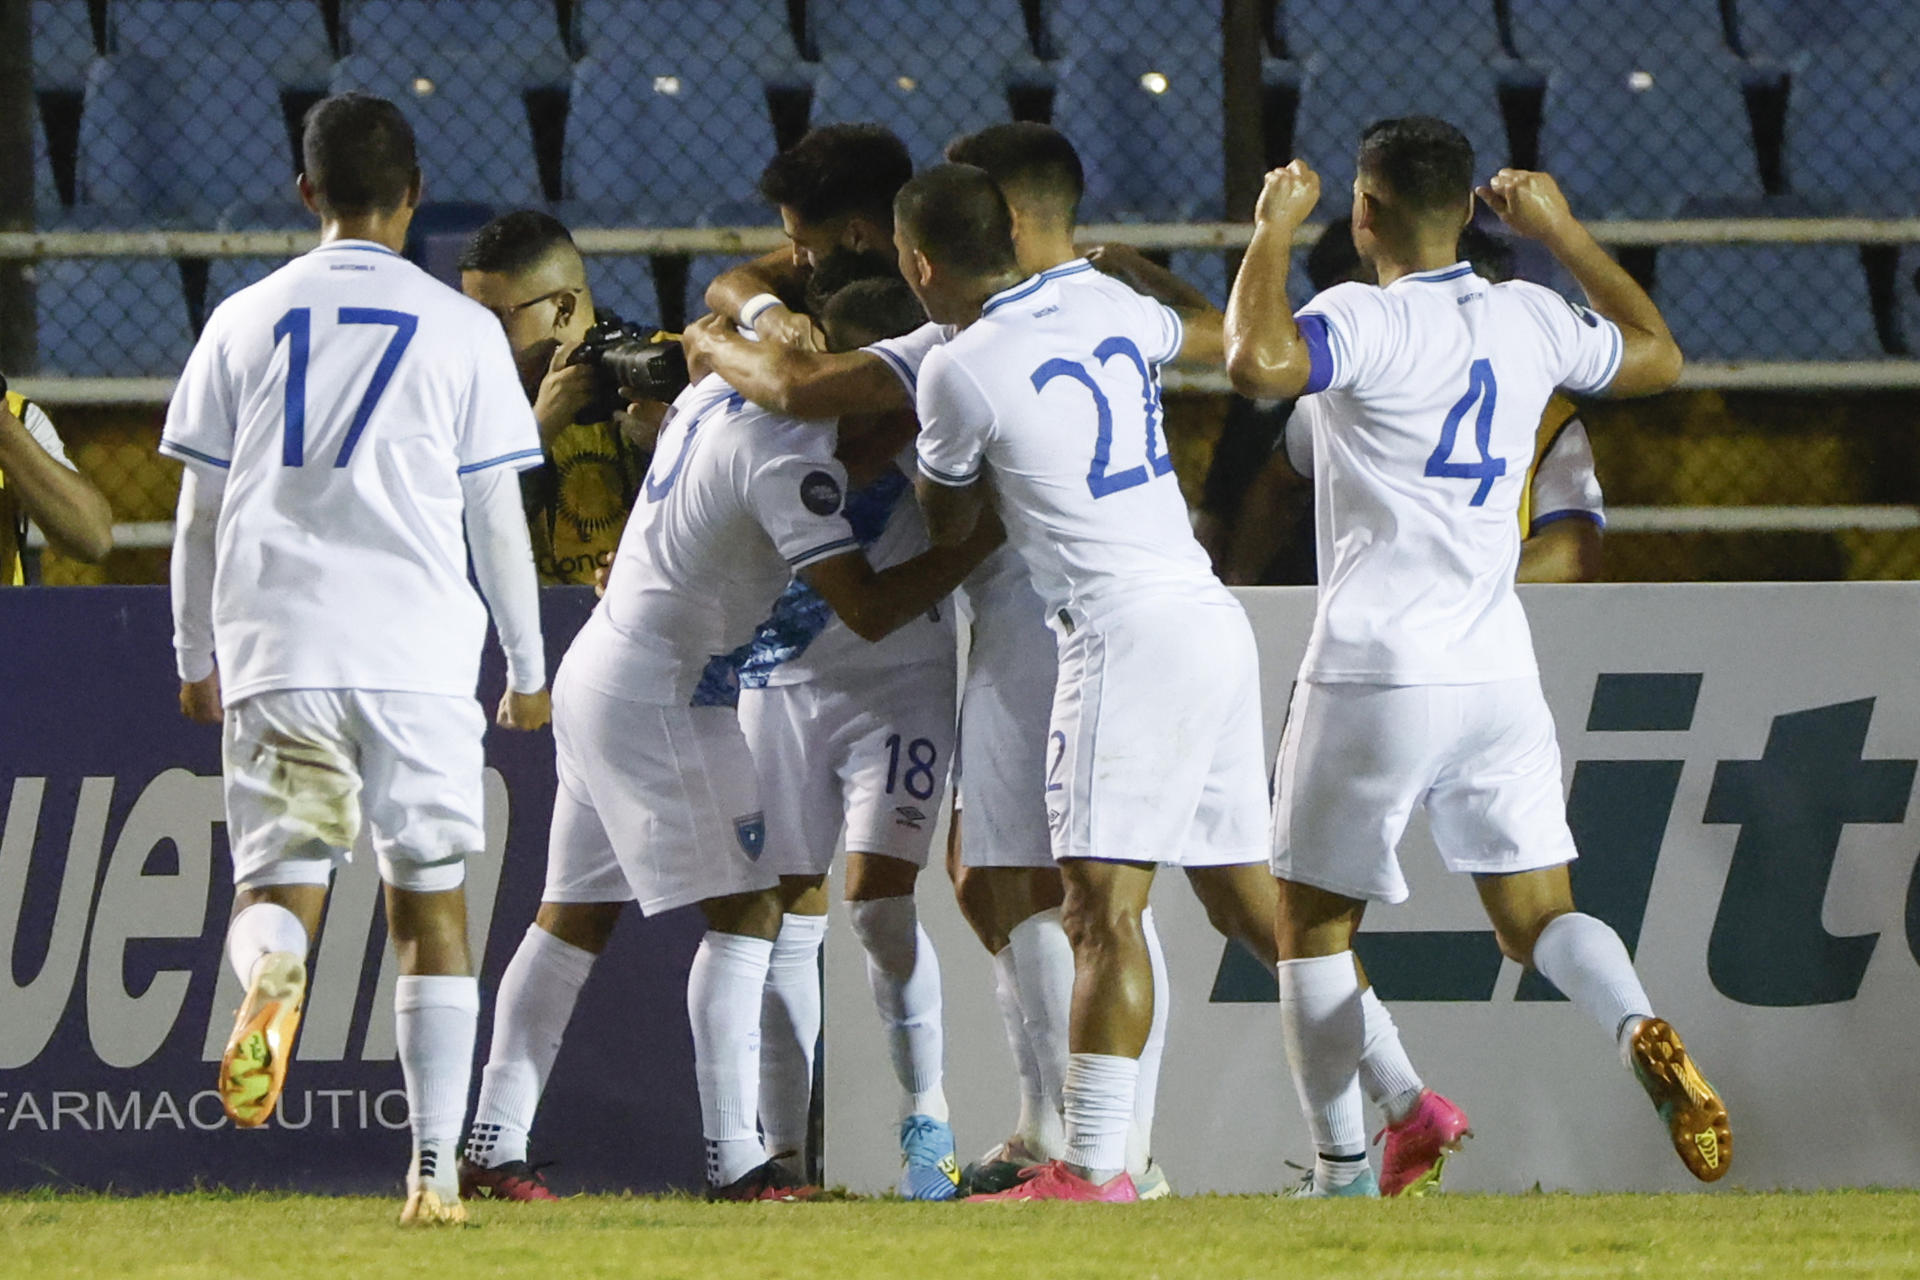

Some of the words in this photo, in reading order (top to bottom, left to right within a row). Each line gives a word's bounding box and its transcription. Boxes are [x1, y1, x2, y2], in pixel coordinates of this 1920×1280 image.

[273, 306, 419, 469] 17
[1030, 335, 1175, 500] 22
[1423, 357, 1507, 507] 4
[885, 733, 937, 801] 18
[1046, 729, 1067, 792] 2
